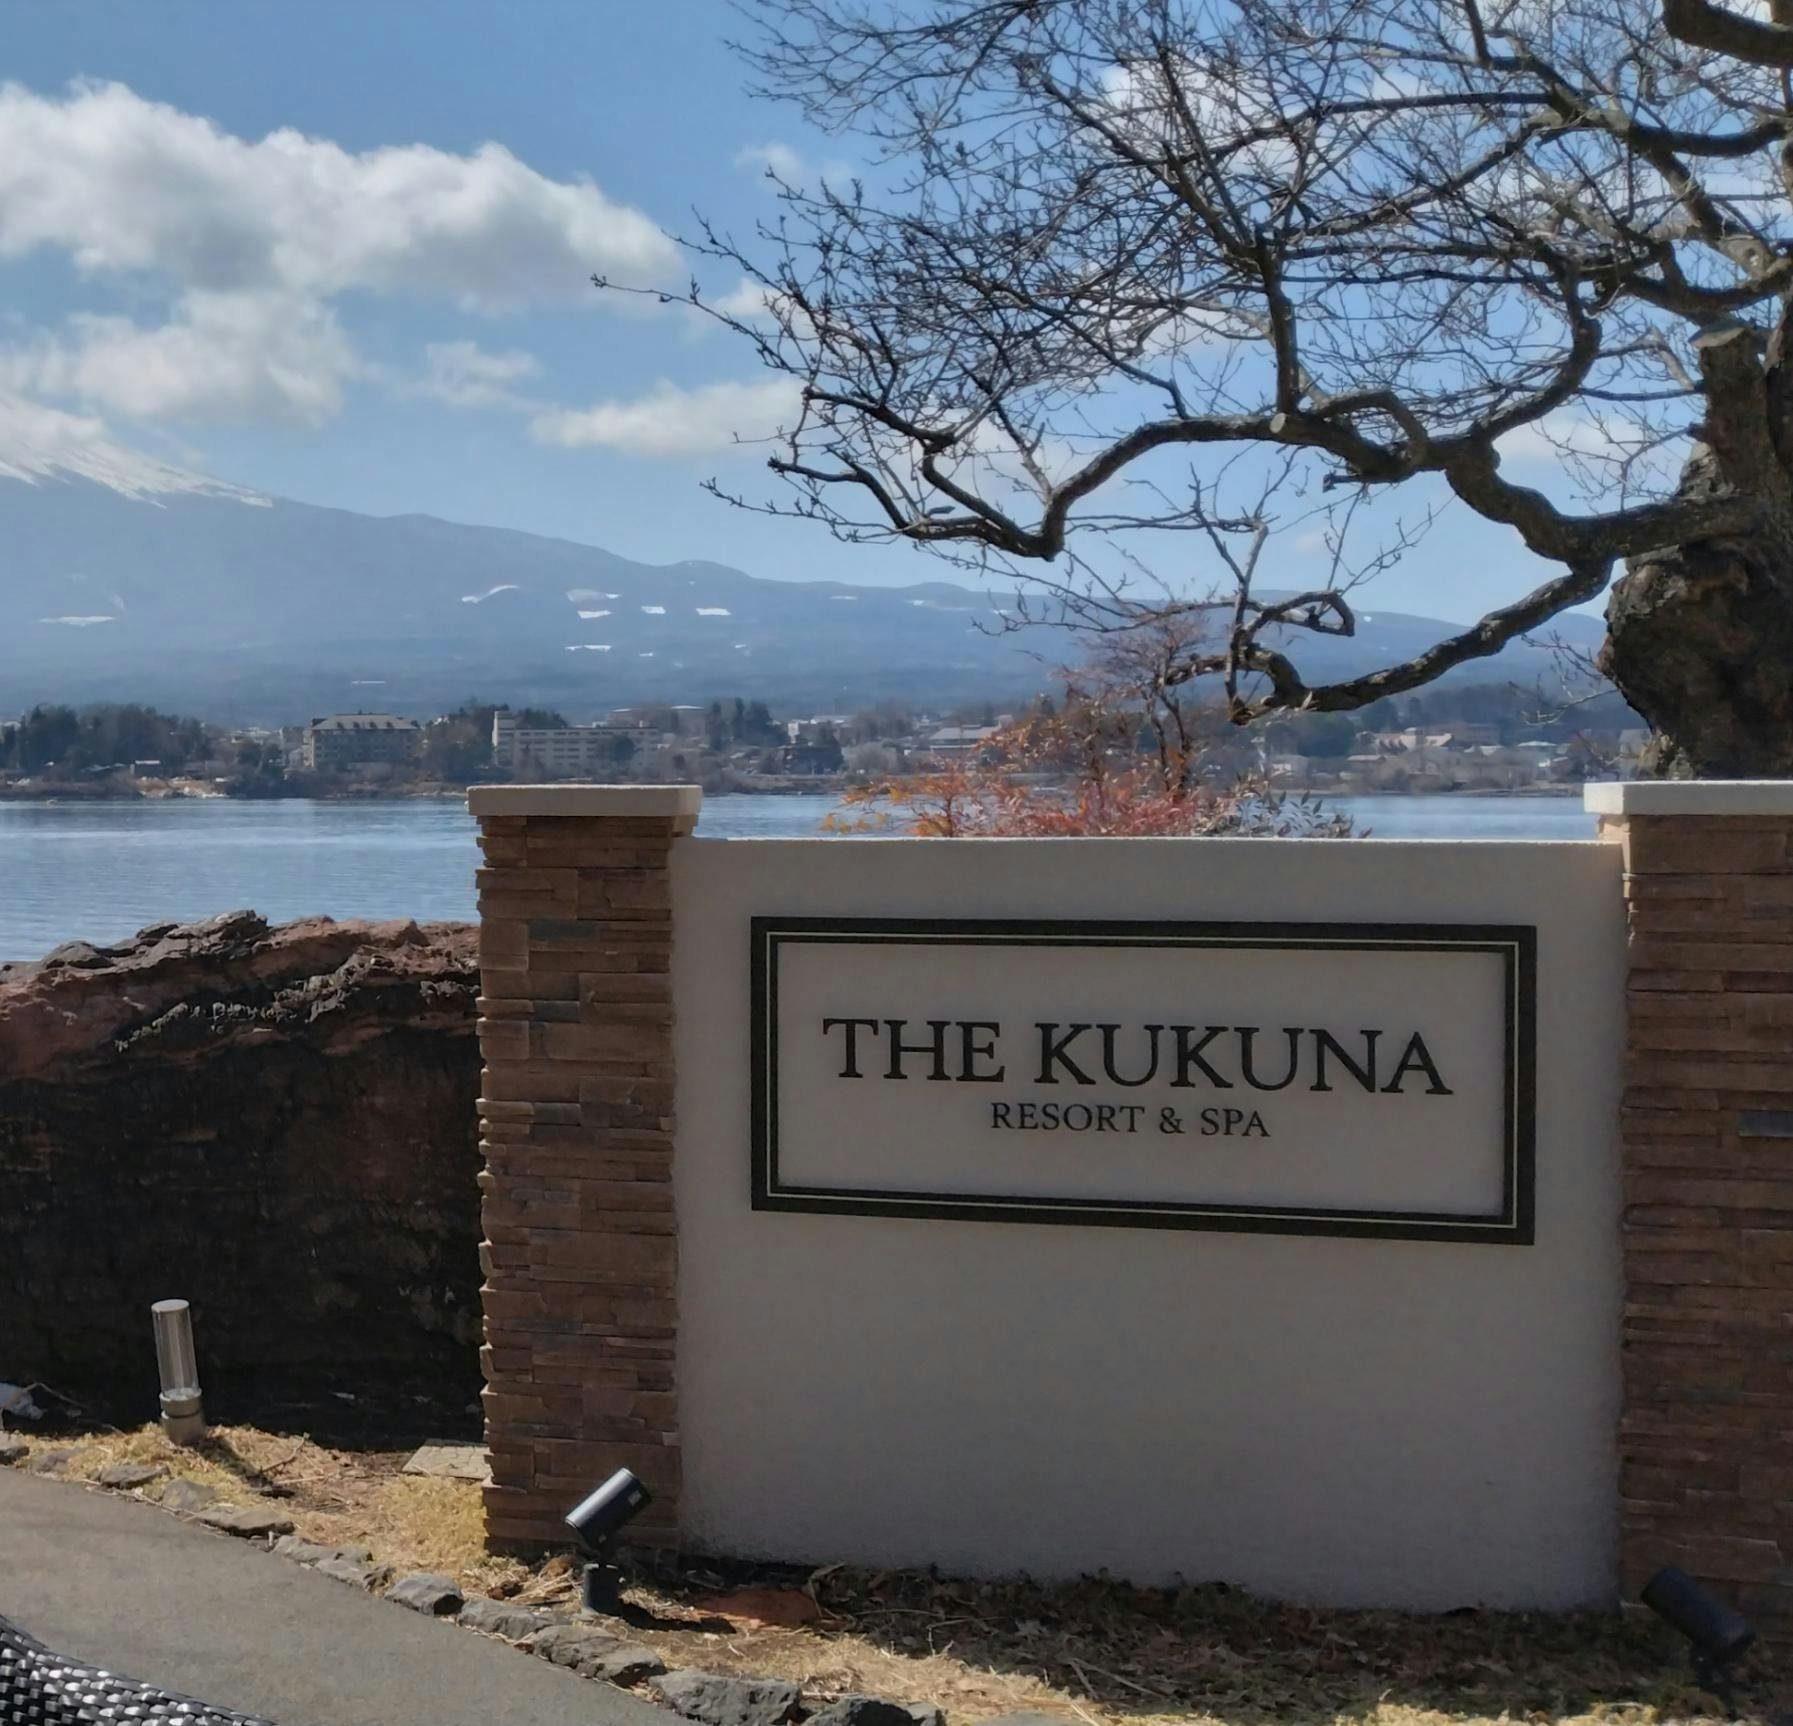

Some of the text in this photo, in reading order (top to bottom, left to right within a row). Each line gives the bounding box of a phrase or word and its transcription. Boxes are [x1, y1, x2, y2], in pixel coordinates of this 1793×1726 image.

[822, 1018, 1454, 1095] THE KUKUNA
[990, 1102, 1271, 1138] RESORT & SPA
